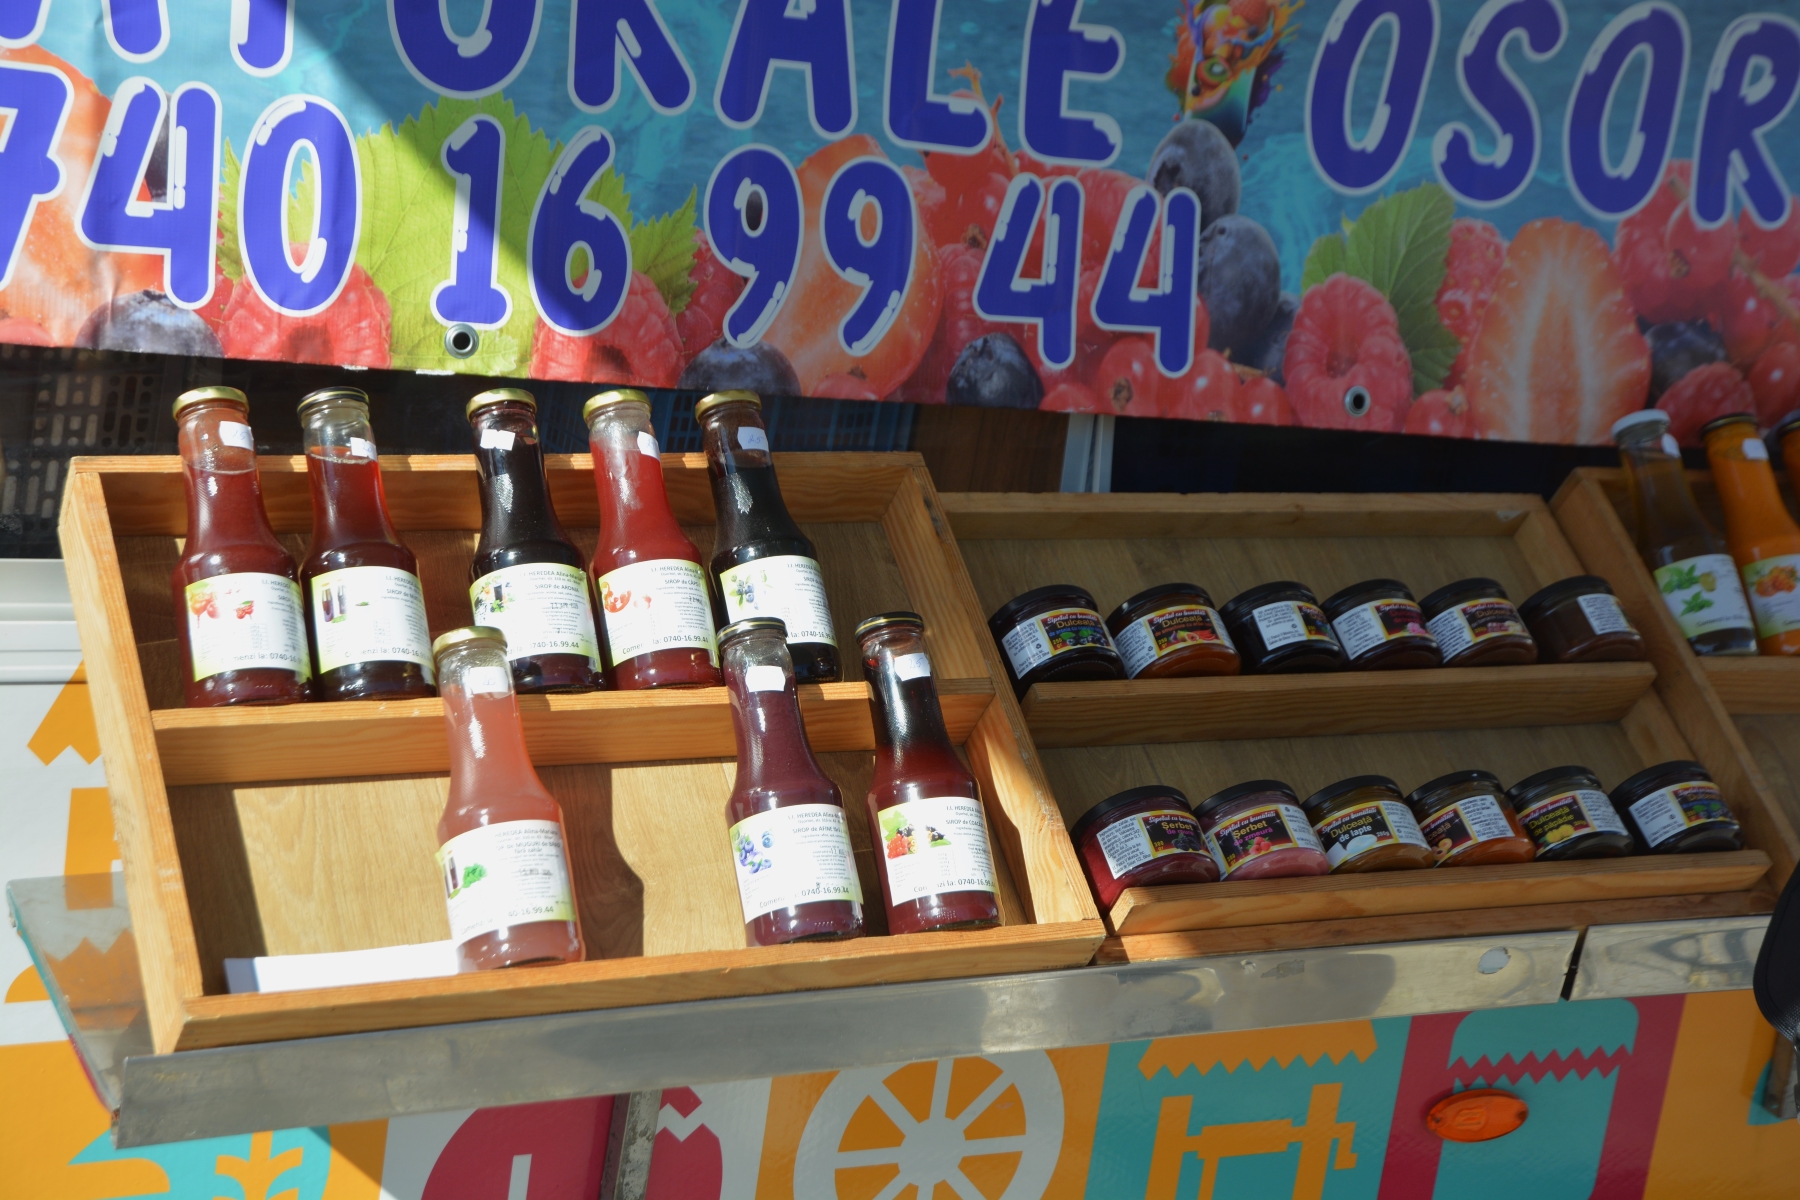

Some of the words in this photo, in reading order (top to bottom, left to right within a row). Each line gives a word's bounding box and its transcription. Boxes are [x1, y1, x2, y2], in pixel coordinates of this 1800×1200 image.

[430, 116, 632, 336] 16
[703, 143, 917, 358] 99
[972, 172, 1200, 378] 44
[748, 432, 764, 444] 25
[1056, 619, 1095, 629] Dulceață
[1161, 615, 1203, 628] Dulceață
[530, 640, 580, 649] 740-16.99.44
[663, 634, 709, 644] 0740-16.99.44
[1528, 805, 1571, 830] Dulceață
[792, 826, 810, 834] SIROP
[1232, 820, 1268, 839] Șerbet
[1330, 815, 1374, 839] Dulceață
[1533, 827, 1544, 837] de
[1233, 838, 1243, 847] de
[1244, 826, 1274, 841] zmeură
[1339, 834, 1350, 844] de
[1350, 824, 1373, 838] lapte
[946, 879, 957, 887] la:
[801, 886, 850, 897] 0740-16.99.44
[508, 906, 555, 917] 40-16.99.44
